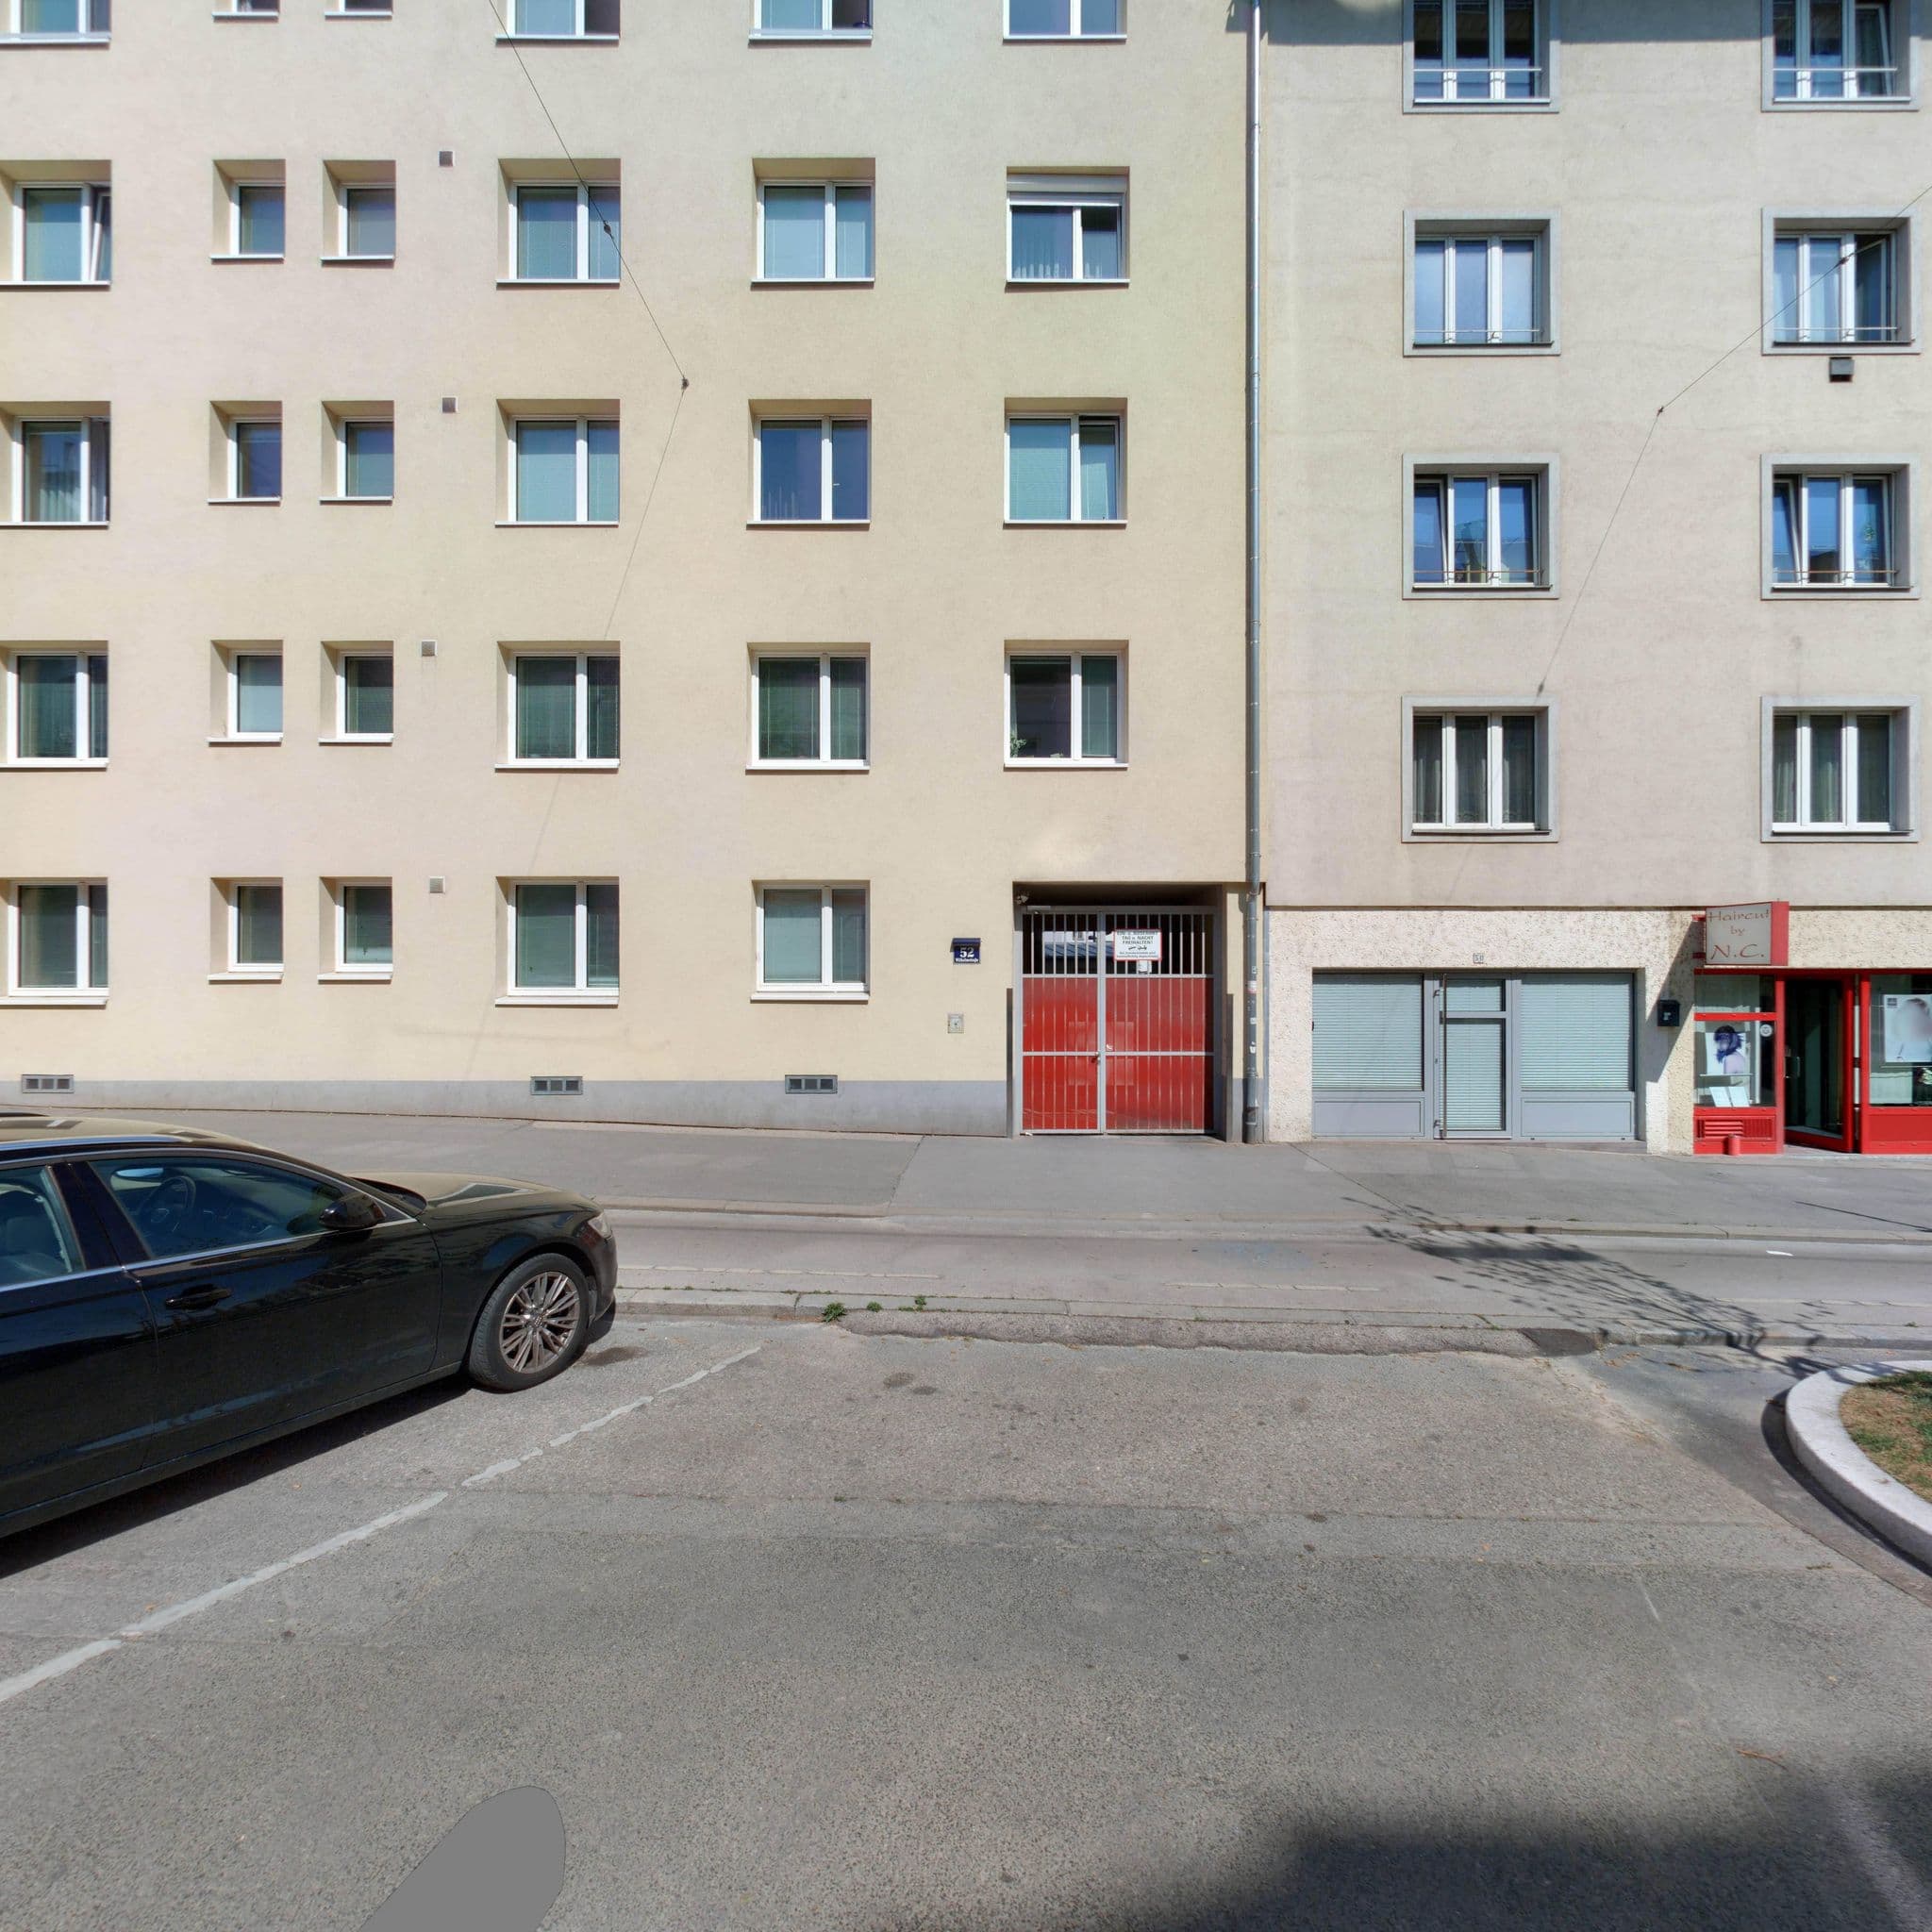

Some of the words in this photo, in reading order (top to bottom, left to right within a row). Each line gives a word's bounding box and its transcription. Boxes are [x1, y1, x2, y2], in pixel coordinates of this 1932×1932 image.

[1707, 909, 1770, 922] Haircut
[1730, 925, 1744, 936] by
[959, 947, 974, 958] 52
[1710, 943, 1764, 960] N.C.
